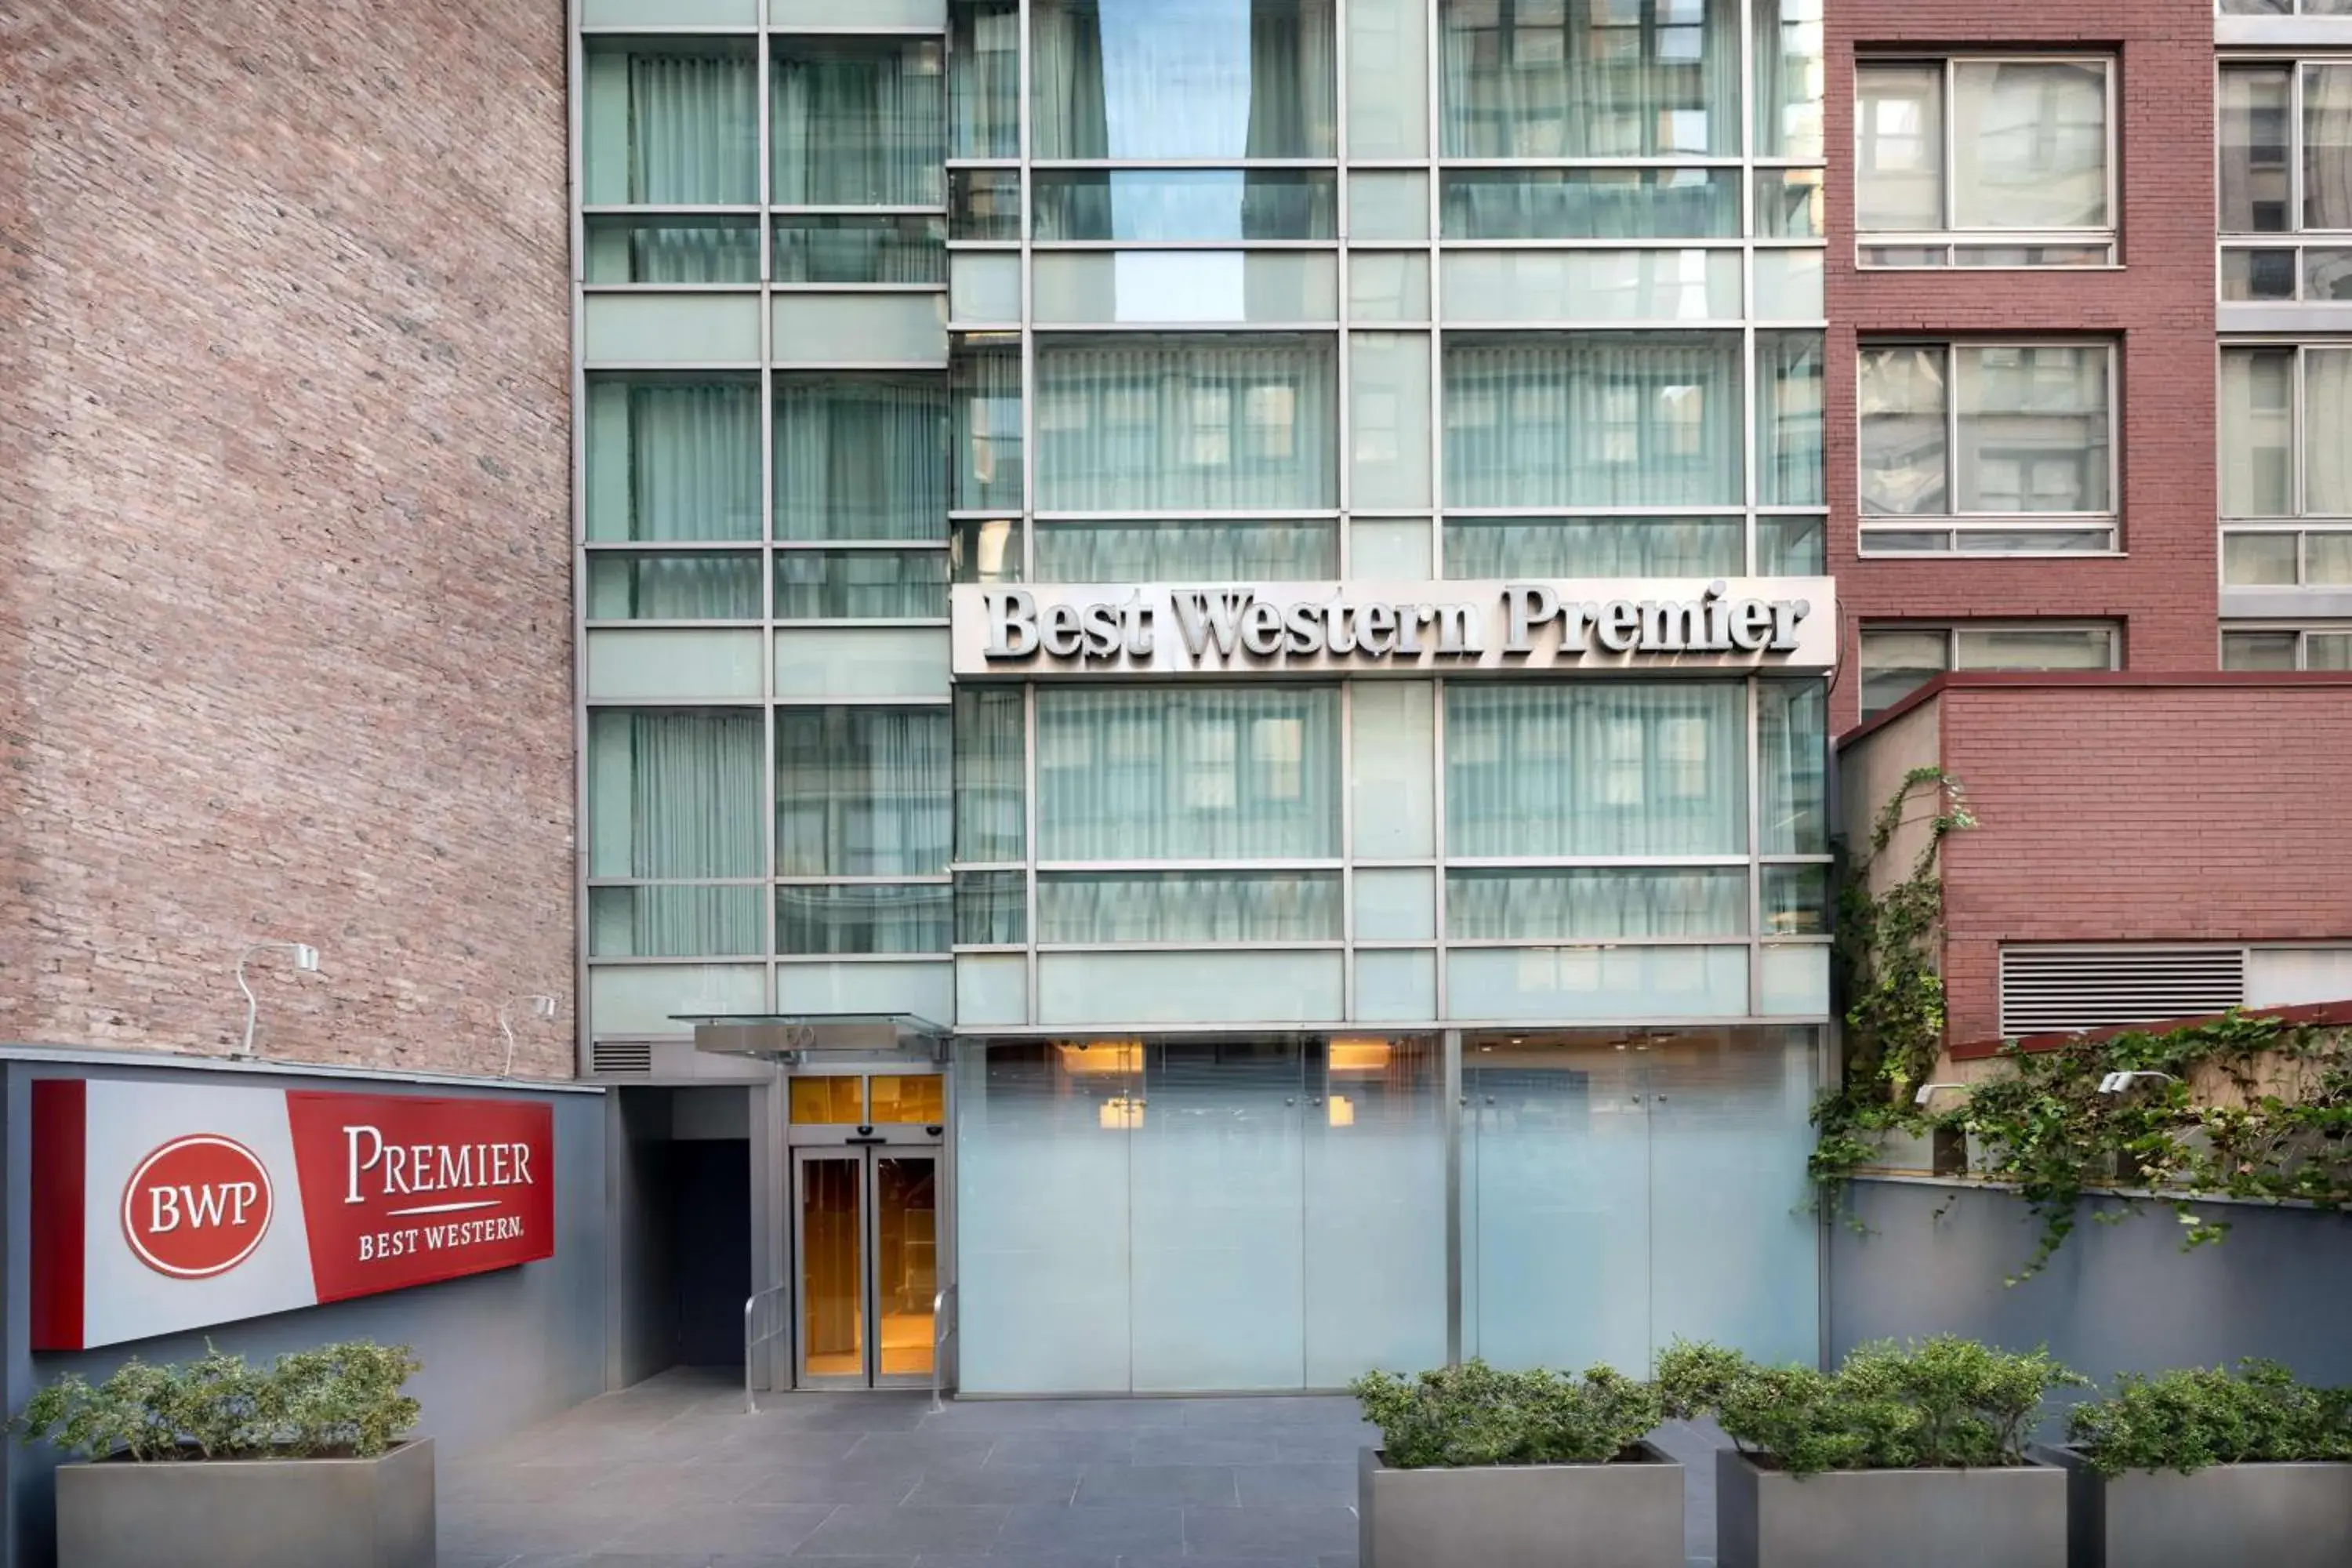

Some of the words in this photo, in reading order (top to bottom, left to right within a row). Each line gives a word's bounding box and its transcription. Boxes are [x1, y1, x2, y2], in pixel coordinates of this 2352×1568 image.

[983, 587, 1154, 659] Best
[1171, 586, 1483, 659] Western
[1501, 579, 1810, 653] Premier
[343, 1125, 533, 1203] PREMIER
[148, 1181, 257, 1233] BWP
[358, 1229, 419, 1261] BEST
